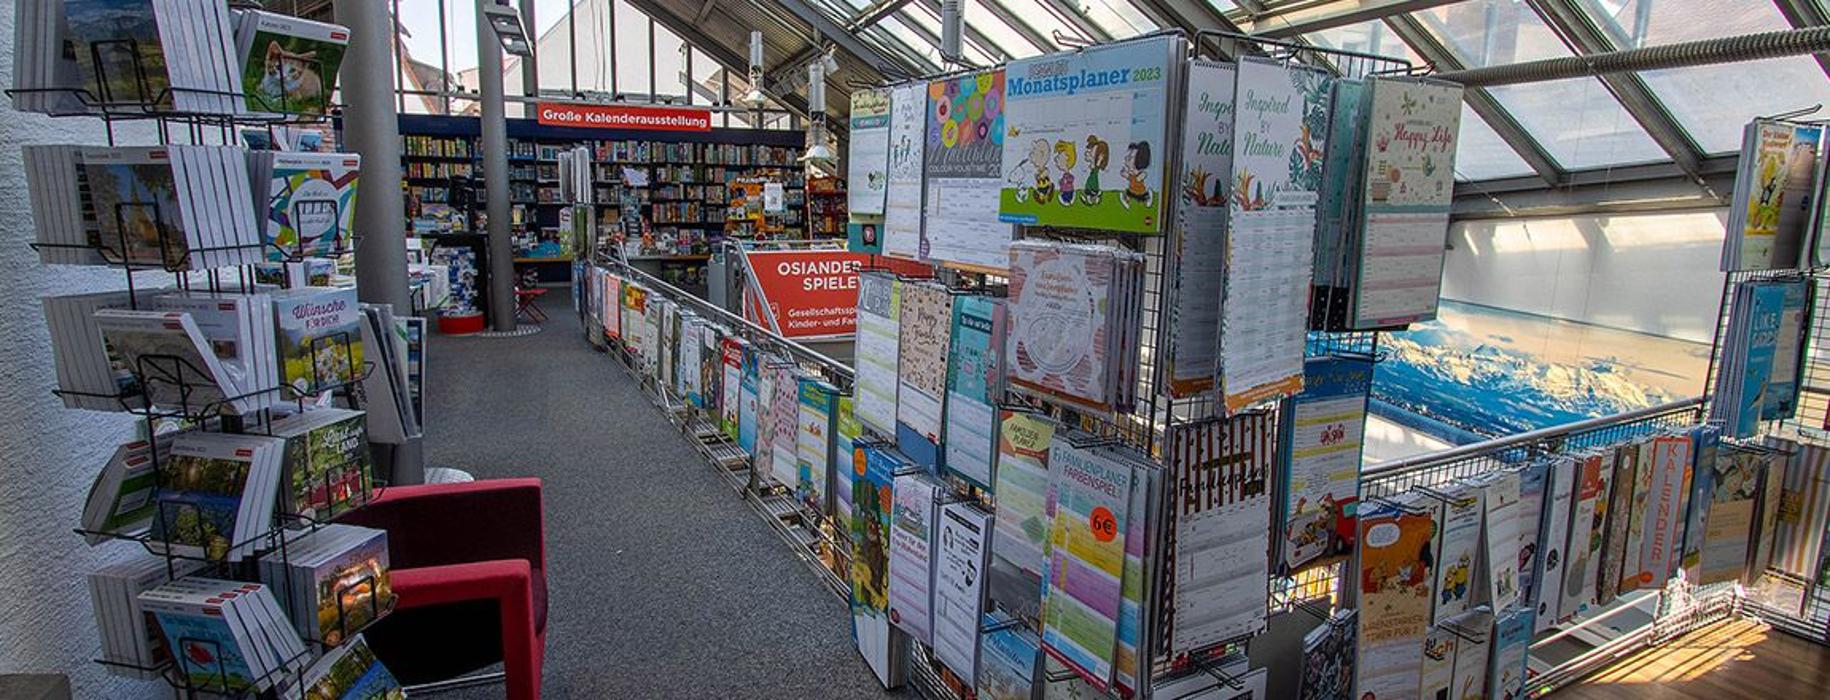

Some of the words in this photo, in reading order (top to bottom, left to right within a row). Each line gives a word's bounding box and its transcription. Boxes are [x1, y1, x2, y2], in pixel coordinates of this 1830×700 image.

[1007, 66, 1131, 97] Monatsplaner
[1132, 67, 1162, 82] 2023
[1244, 89, 1291, 120] Inspired
[543, 109, 582, 122] Große
[585, 111, 708, 129] Kalenderausstellung
[1218, 121, 1232, 135] BY
[1260, 121, 1271, 135] BY
[1243, 132, 1285, 157] Nature
[1394, 122, 1428, 152] Happy
[1431, 124, 1453, 152] Life
[803, 276, 860, 291] SPIELE
[292, 300, 346, 320] Wünsche
[305, 319, 321, 329] FÜR
[788, 319, 821, 329] Kinder-
[822, 318, 841, 328] und
[1064, 464, 1116, 497] FARBENSPIEL
[1652, 444, 1678, 561] KALENDER
[1093, 514, 1114, 536] 6€
